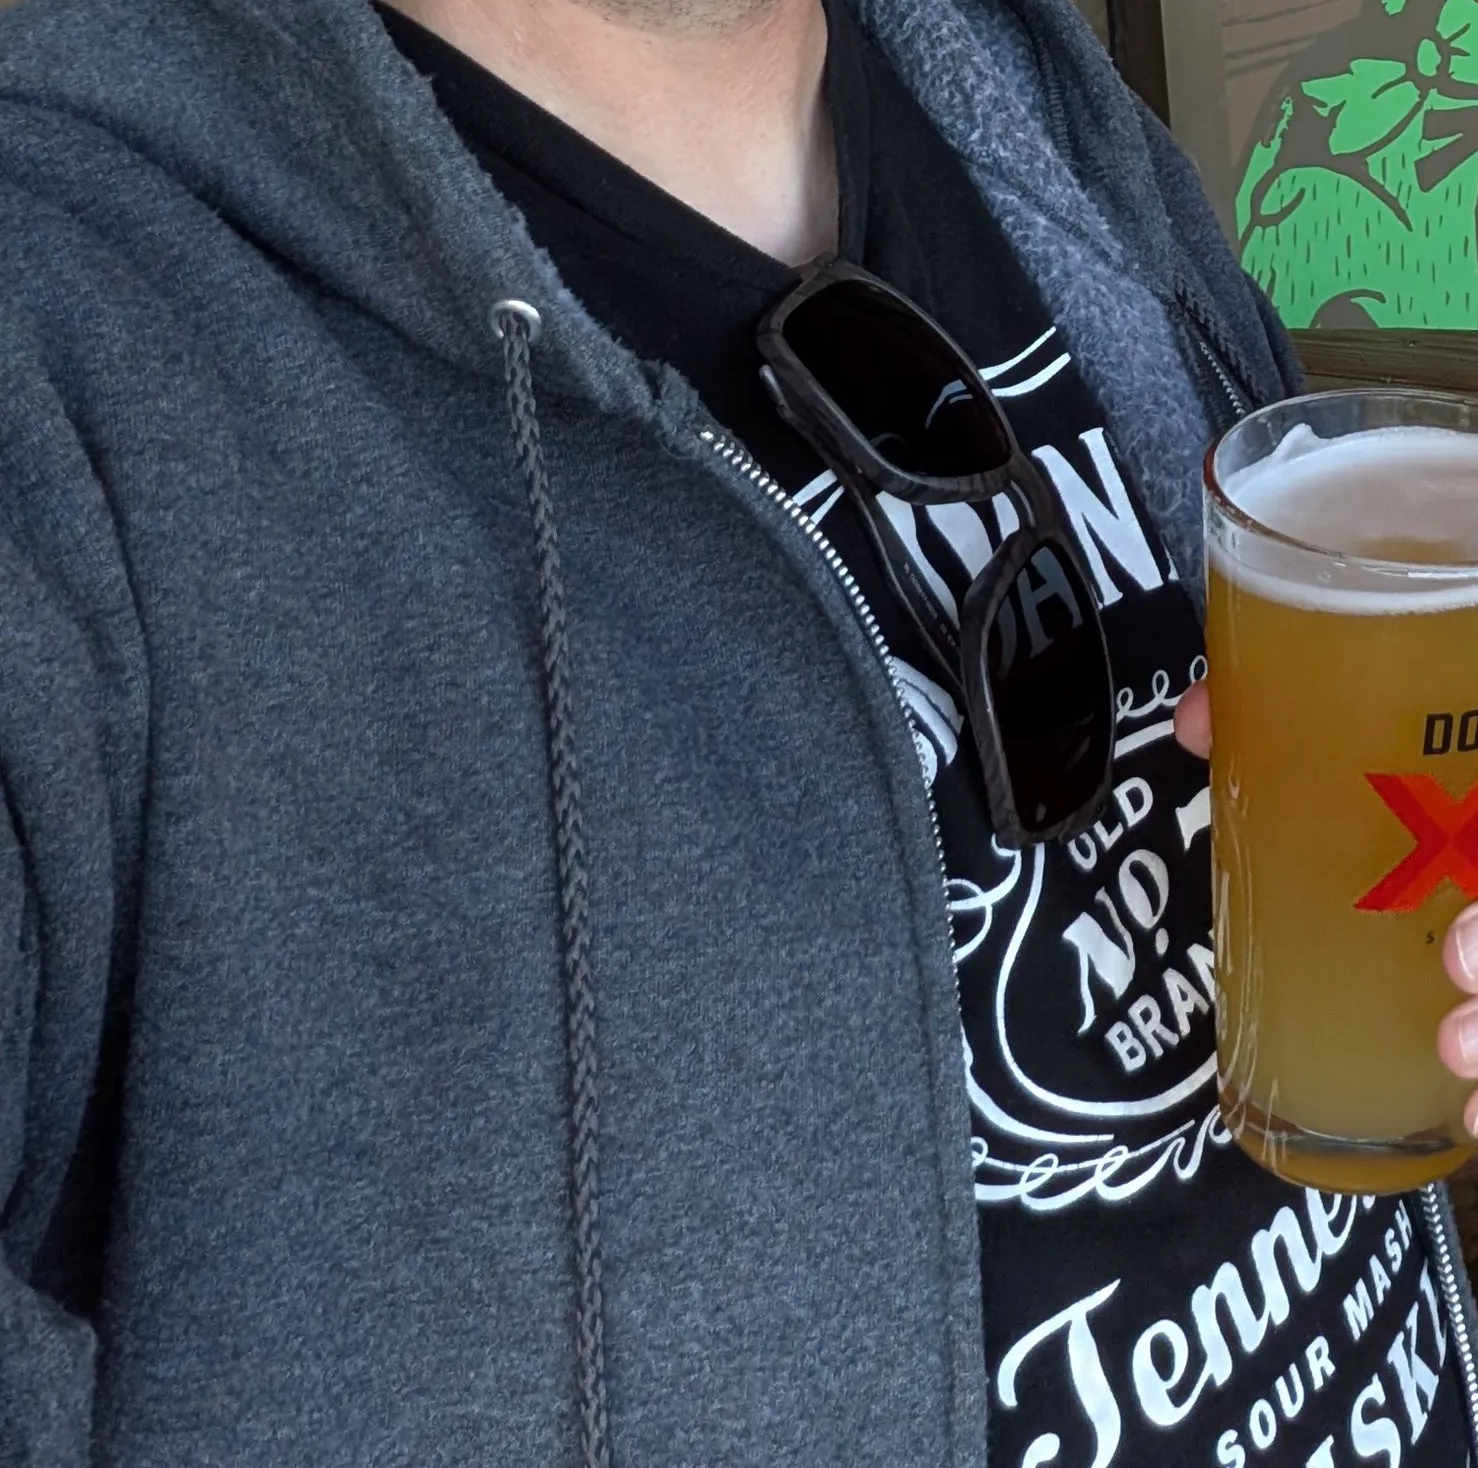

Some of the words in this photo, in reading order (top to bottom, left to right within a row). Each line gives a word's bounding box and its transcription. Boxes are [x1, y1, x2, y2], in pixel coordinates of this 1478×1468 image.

[1067, 776, 1154, 870] OLD
[998, 1187, 1377, 1468] Tenne
[1216, 1335, 1337, 1468] SOUR
[1342, 1198, 1413, 1342] MASH
